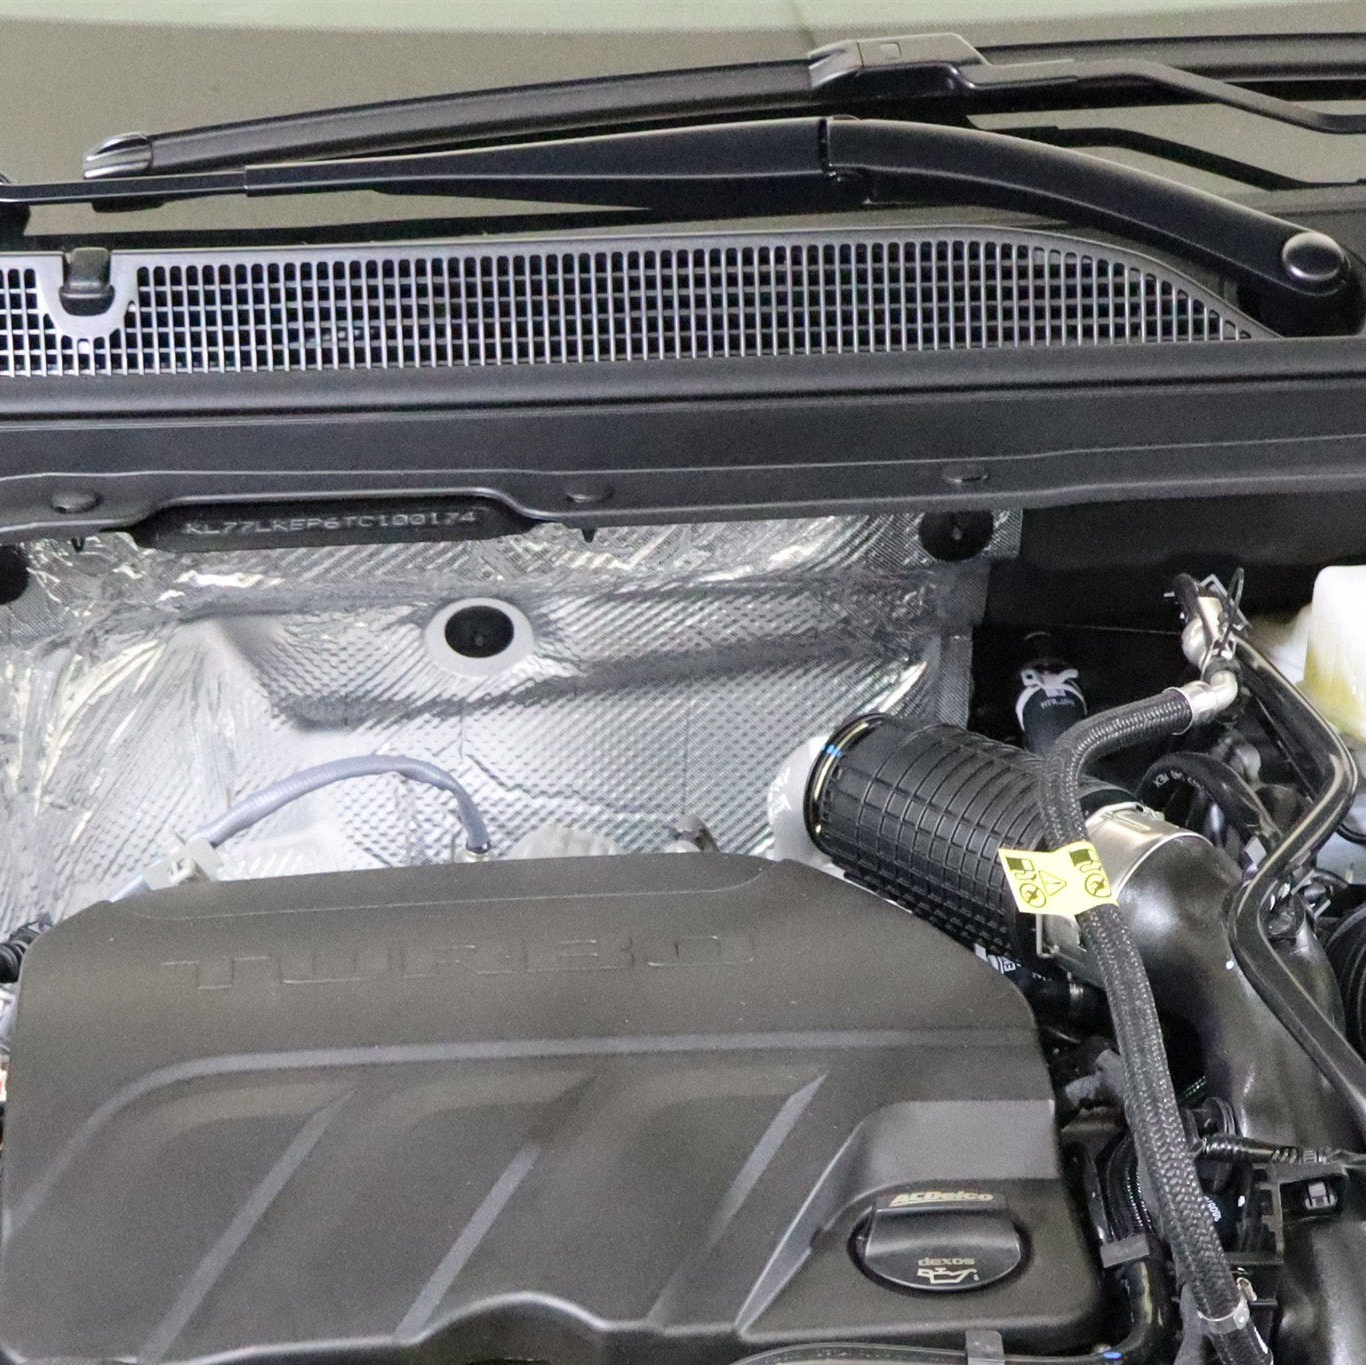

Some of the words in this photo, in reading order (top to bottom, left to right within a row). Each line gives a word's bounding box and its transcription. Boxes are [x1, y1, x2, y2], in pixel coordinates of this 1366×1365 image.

[160, 934, 754, 990] TURBO
[889, 1190, 994, 1207] ACDelco
[917, 1257, 976, 1266] dexos
